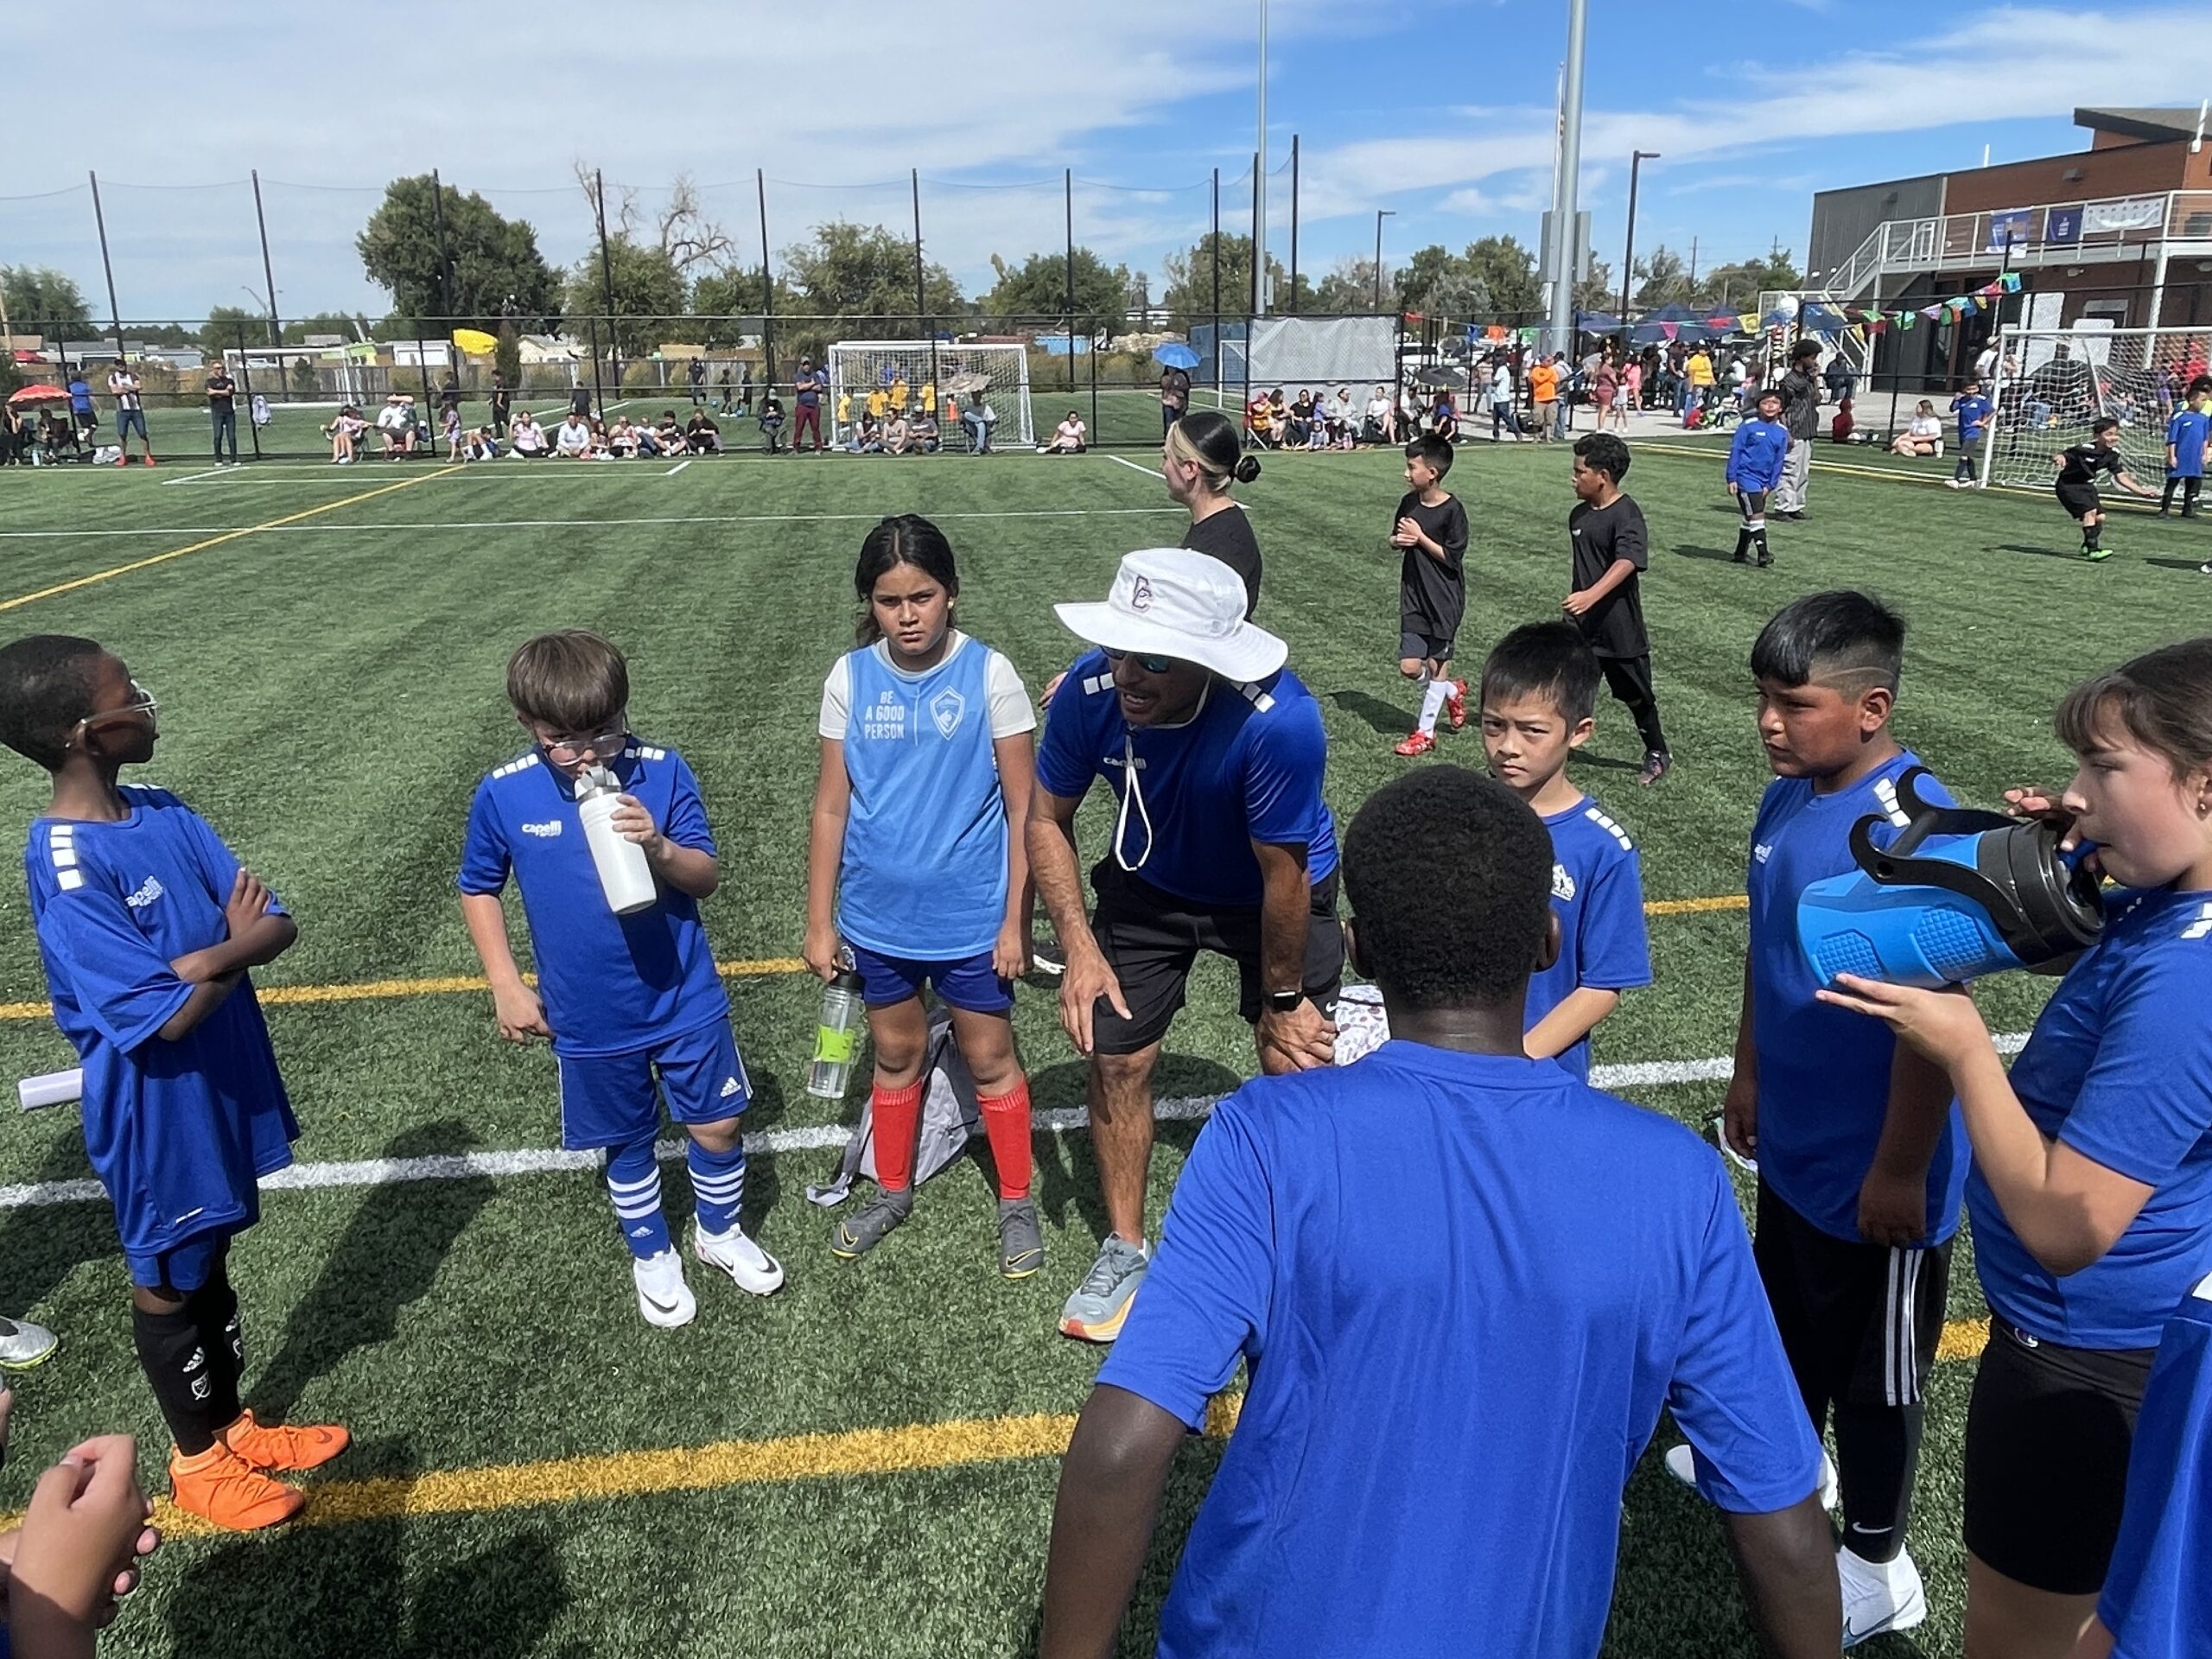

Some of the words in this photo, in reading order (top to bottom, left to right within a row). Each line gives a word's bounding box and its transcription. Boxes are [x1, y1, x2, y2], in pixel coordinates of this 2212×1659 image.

[880, 690, 894, 704] BE
[865, 705, 873, 721] A
[875, 705, 905, 721] GOOD
[864, 723, 905, 740] PERSON
